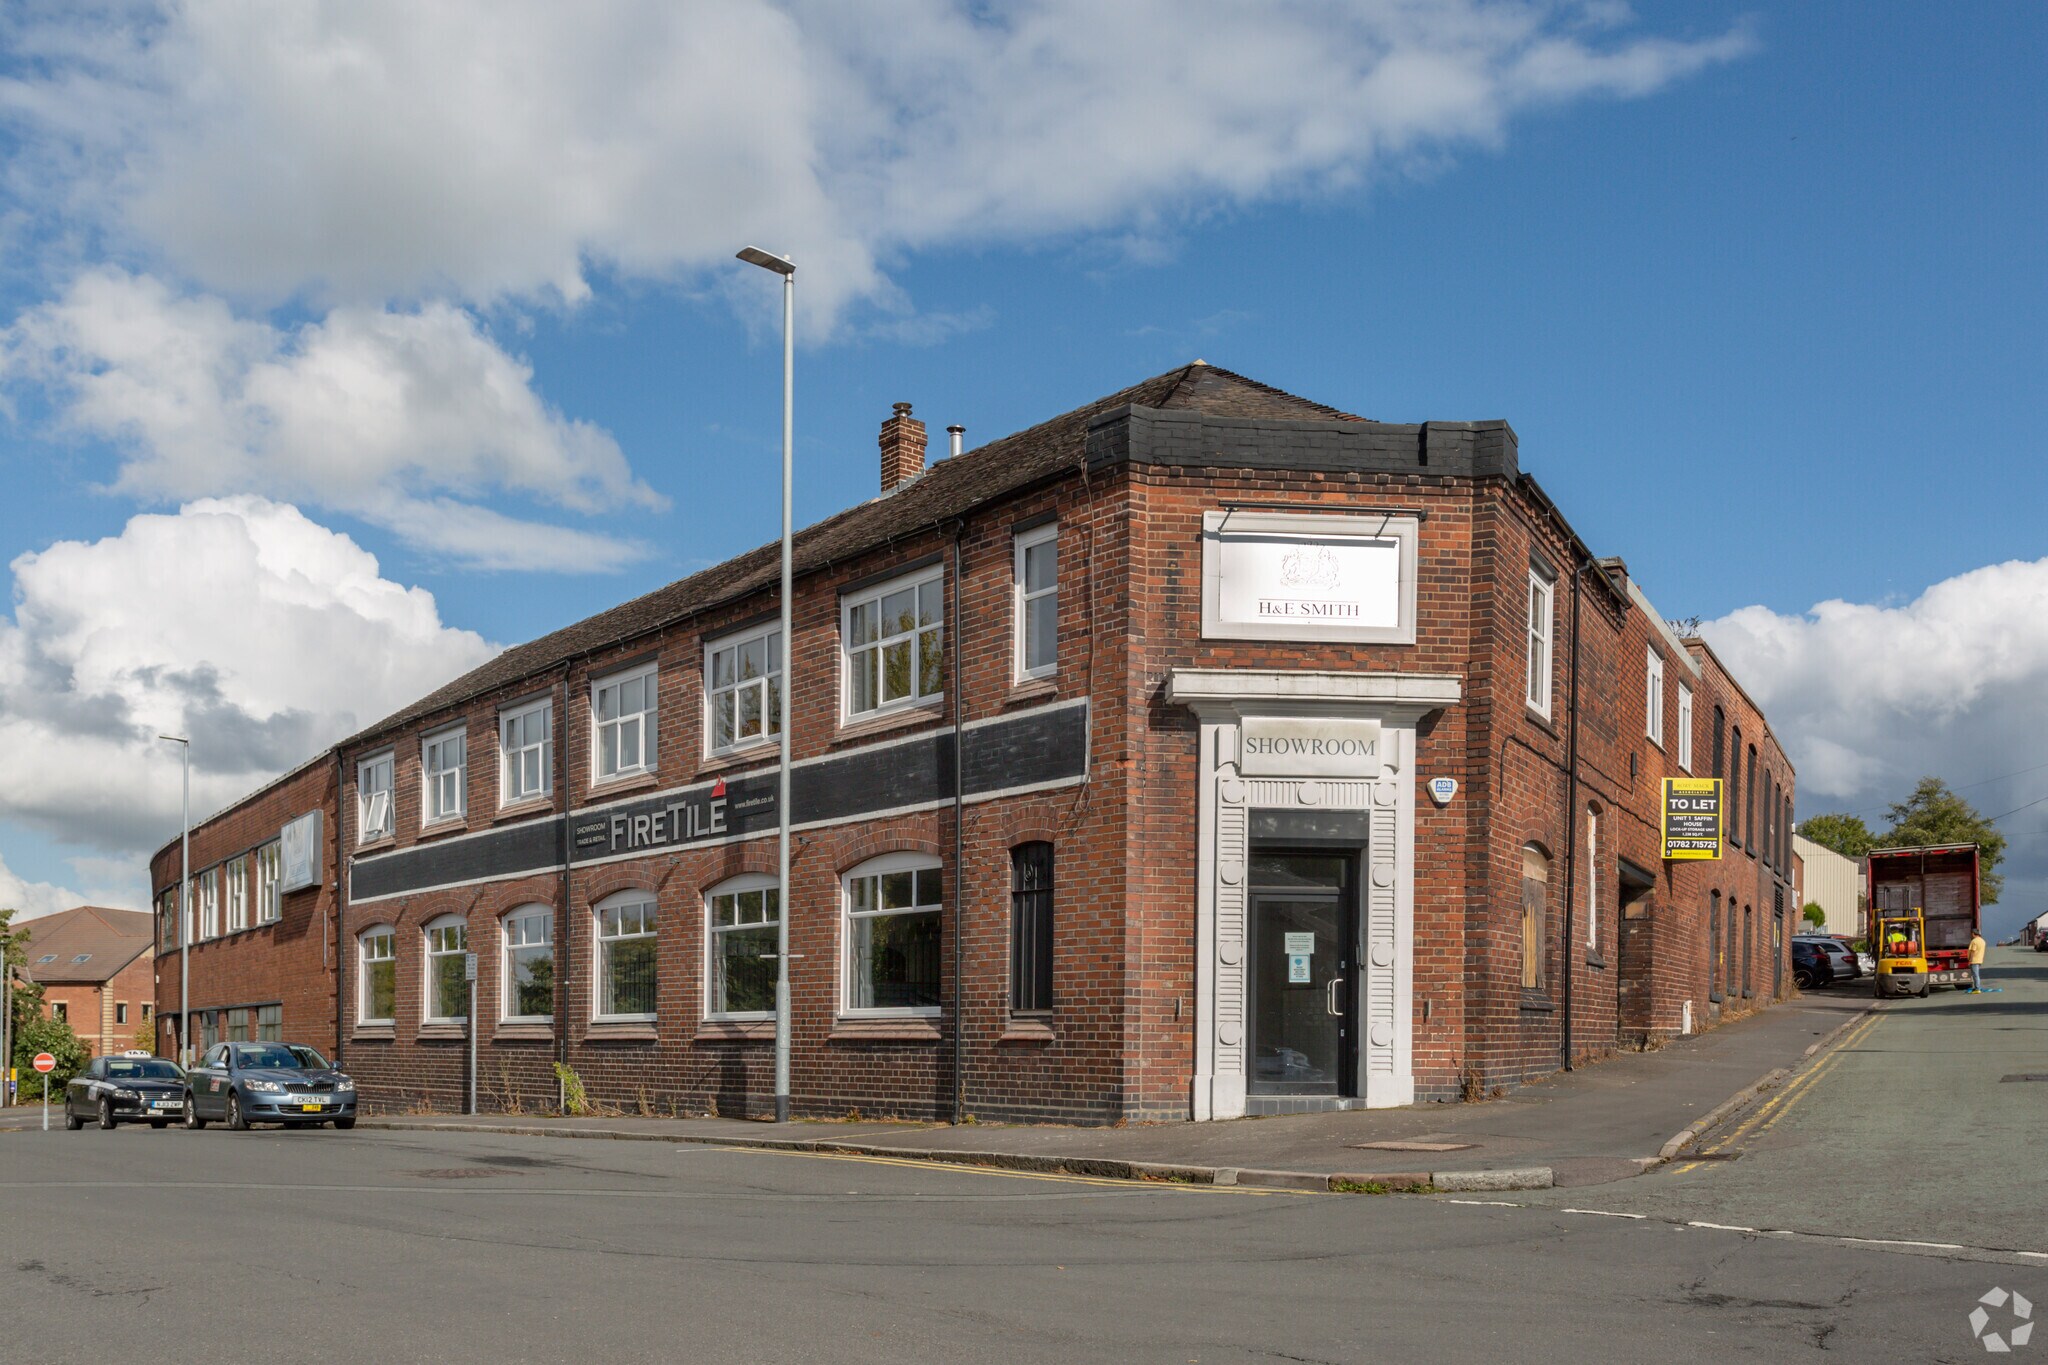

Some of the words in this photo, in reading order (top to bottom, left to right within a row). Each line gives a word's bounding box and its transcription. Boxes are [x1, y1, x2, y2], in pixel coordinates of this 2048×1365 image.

[1259, 602, 1295, 615] H&E
[1300, 603, 1359, 617] SMITH
[1245, 736, 1376, 757] SHOWROOM
[735, 794, 774, 809] www.firetile.co.uk
[1669, 799, 1689, 810] TO
[1692, 799, 1717, 810] LET
[576, 822, 606, 835] SHOWROOM
[1691, 841, 1717, 849] 715725
